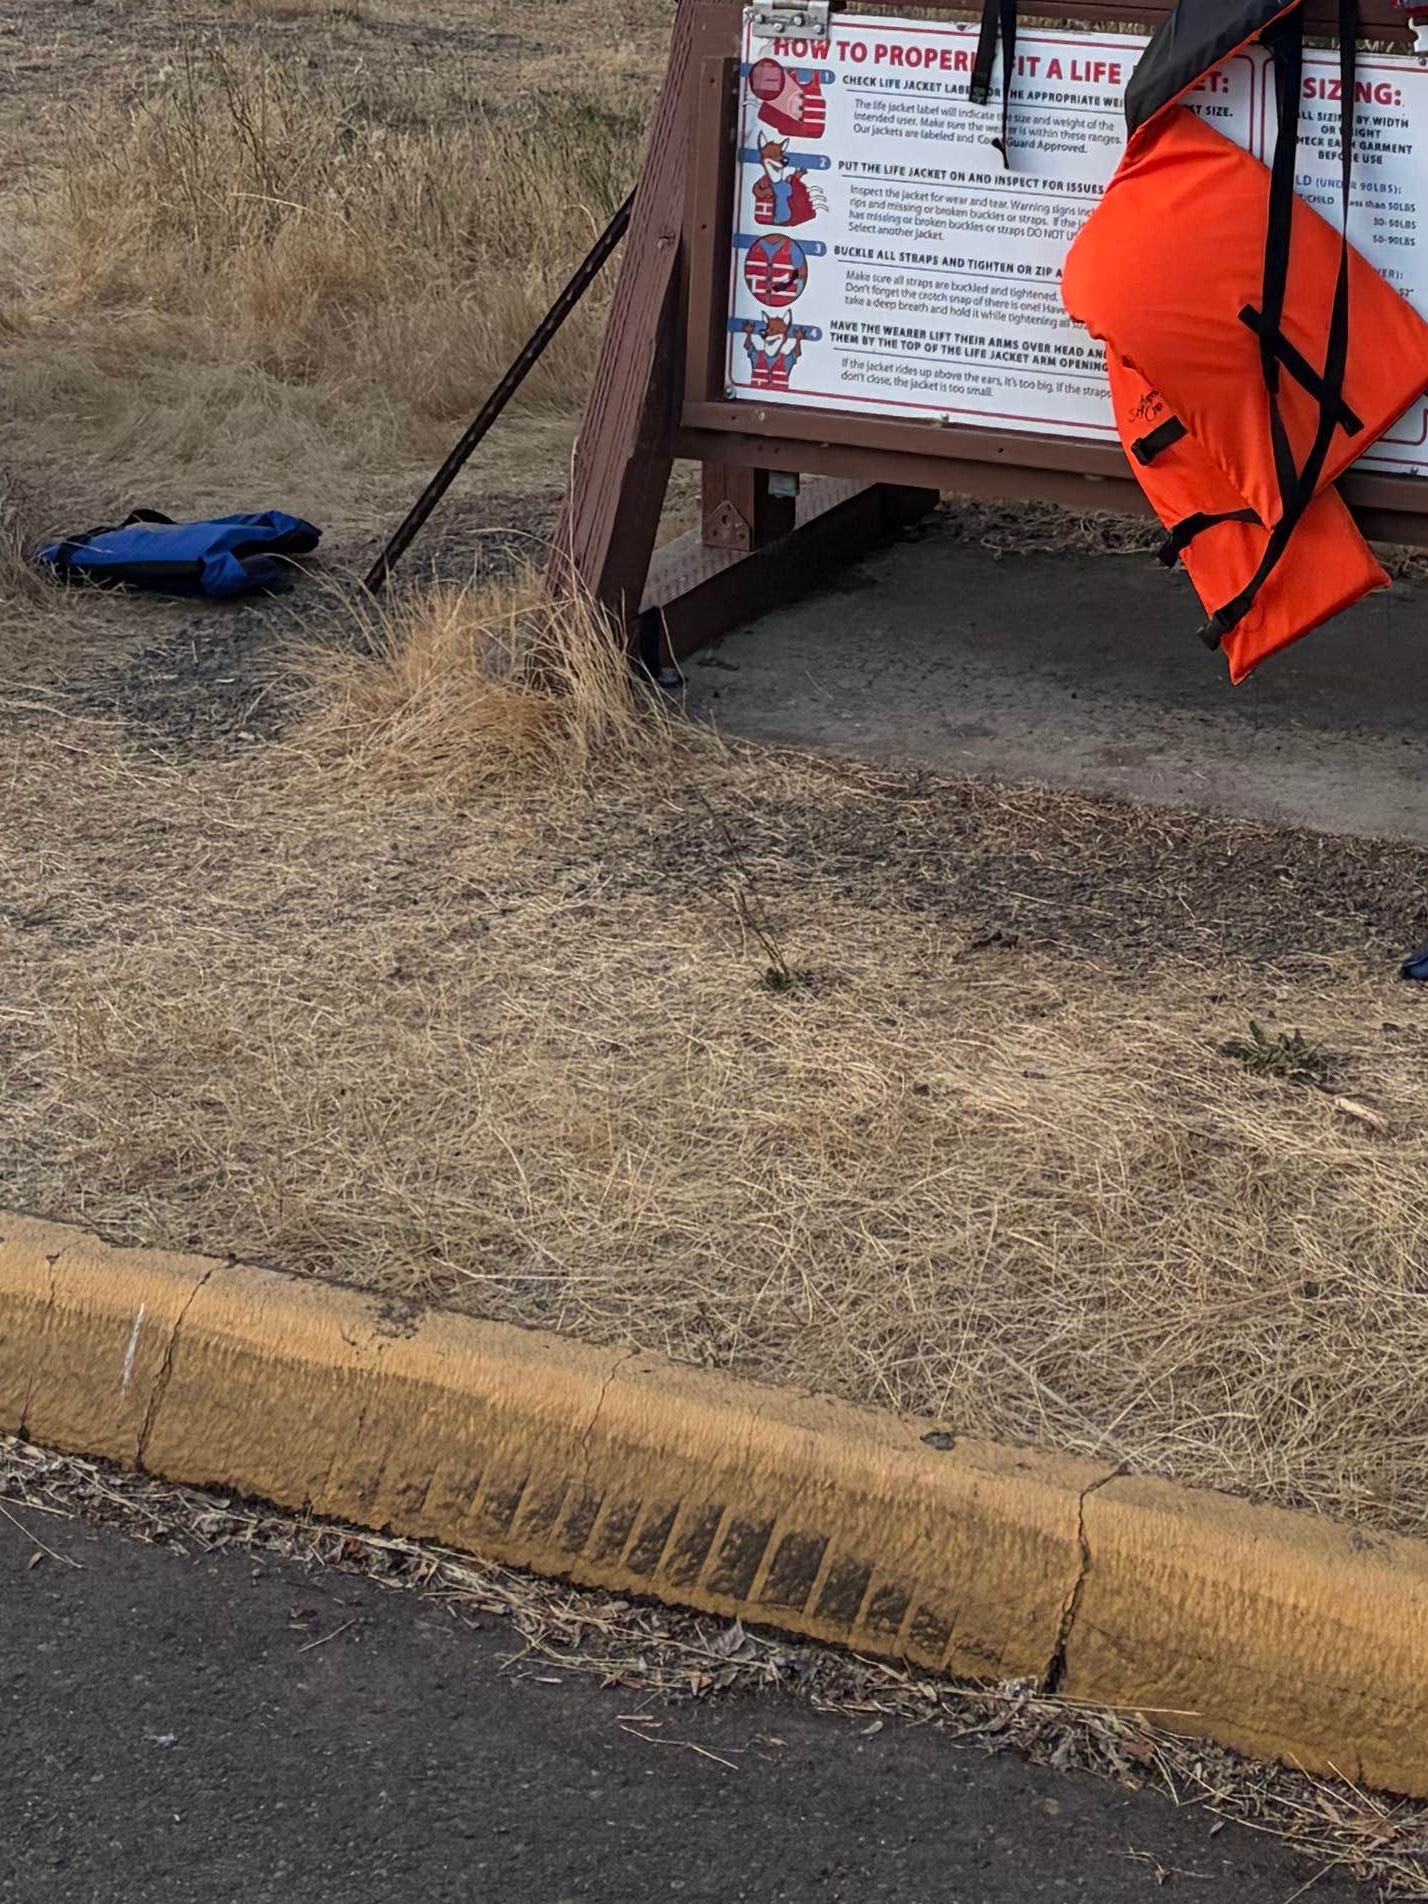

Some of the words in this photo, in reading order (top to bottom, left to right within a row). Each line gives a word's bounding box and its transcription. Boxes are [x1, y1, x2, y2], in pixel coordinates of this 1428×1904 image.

[774, 39, 830, 60] HOW
[836, 41, 868, 64] TO
[1046, 58, 1064, 80] A
[1070, 59, 1122, 85] LIFE
[1303, 77, 1402, 107] SIZNG:
[838, 160, 858, 171] PUT
[861, 162, 880, 174] THE
[884, 165, 905, 176] LIFE
[909, 167, 946, 179] JACKET
[950, 171, 965, 182] ON
[968, 172, 992, 184] AND
[994, 175, 1039, 188] INSPECT
[1042, 179, 1063, 191] FOR
[1066, 182, 1108, 195] ISSUES
